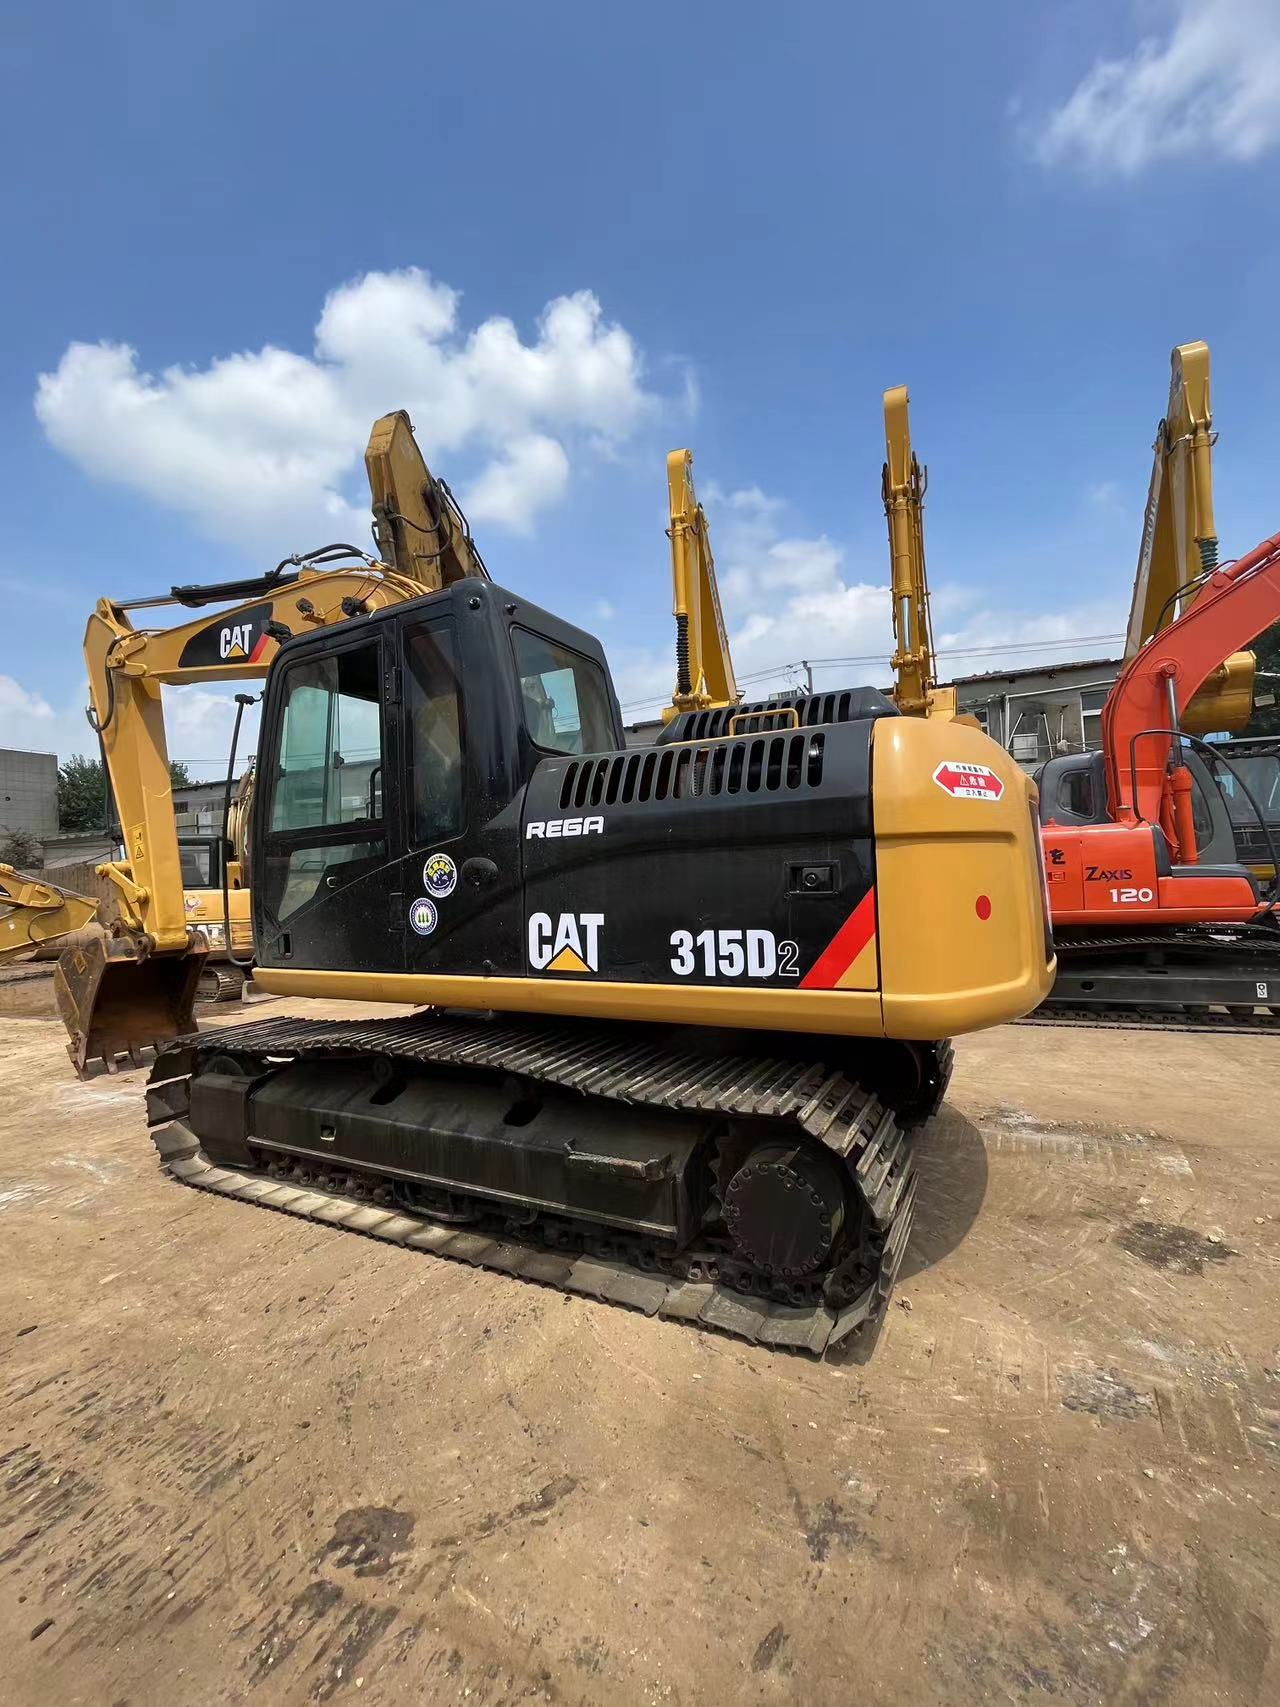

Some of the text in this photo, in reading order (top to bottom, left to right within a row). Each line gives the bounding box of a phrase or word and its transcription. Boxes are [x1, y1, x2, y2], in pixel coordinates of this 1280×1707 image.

[220, 624, 253, 659] CAT
[526, 816, 605, 840] REGA
[1085, 866, 1133, 882] ZAXIS
[1110, 888, 1153, 903] 120
[528, 912, 605, 973] CAT
